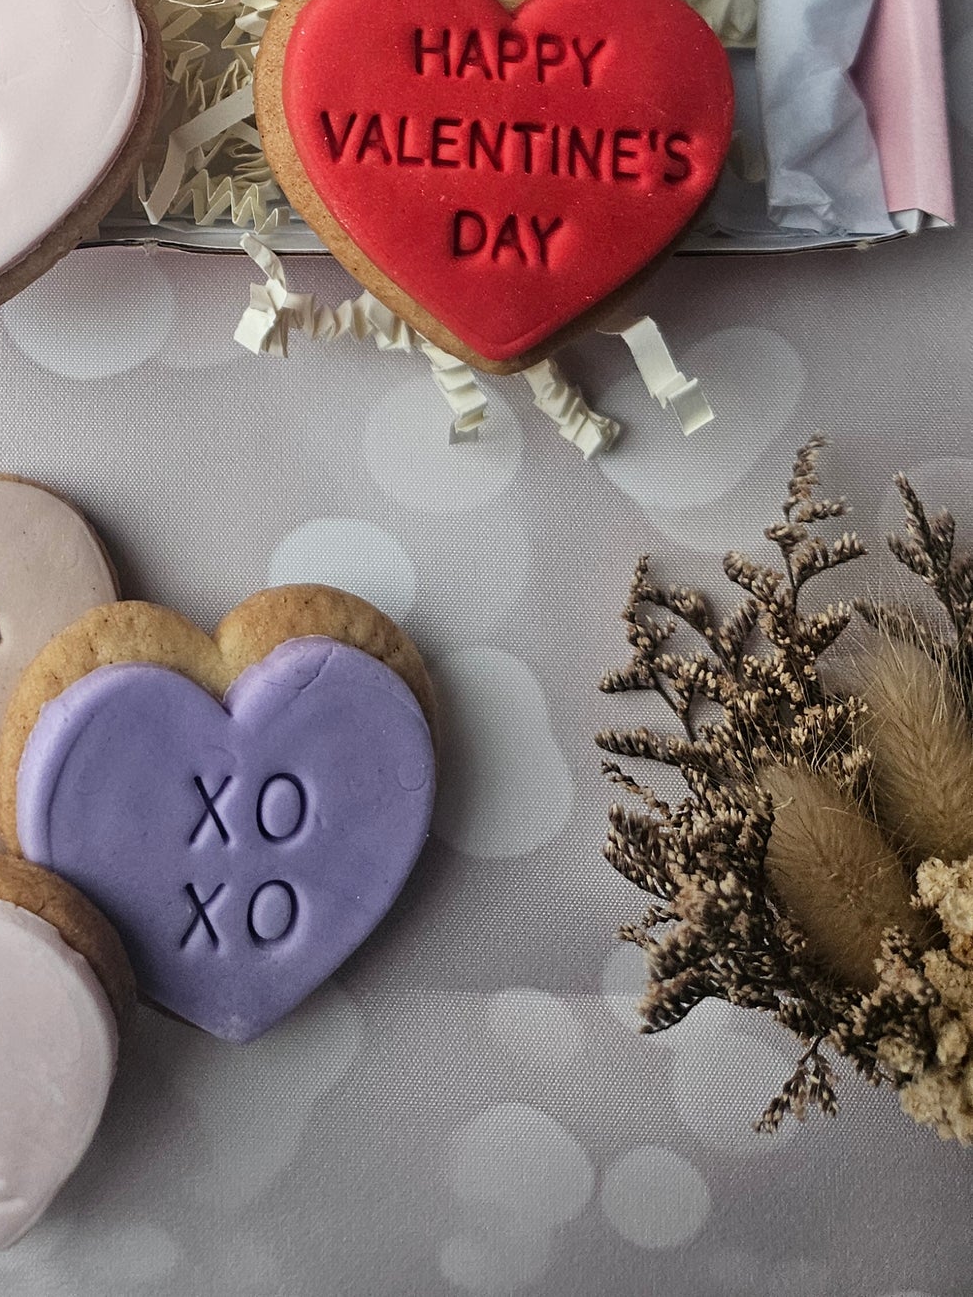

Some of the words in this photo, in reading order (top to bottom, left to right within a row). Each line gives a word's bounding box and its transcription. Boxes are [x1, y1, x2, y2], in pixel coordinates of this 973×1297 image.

[412, 28, 608, 88] HAPPY
[318, 109, 694, 185] VALENTINE'S
[450, 206, 564, 267] DAY
[186, 770, 310, 848] XO
[177, 877, 300, 951] XO
